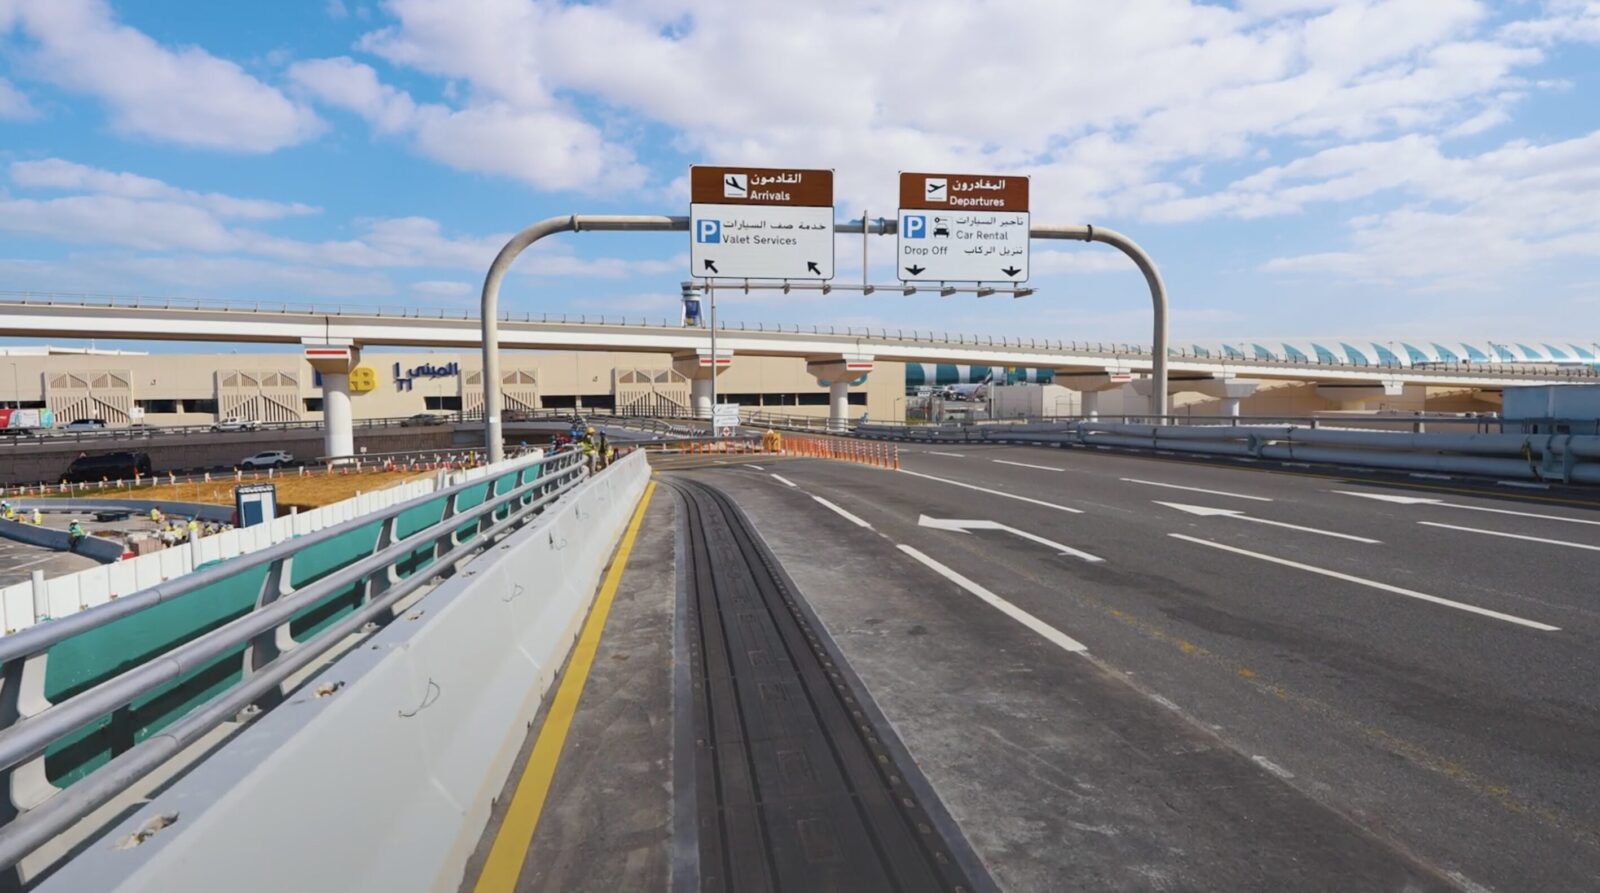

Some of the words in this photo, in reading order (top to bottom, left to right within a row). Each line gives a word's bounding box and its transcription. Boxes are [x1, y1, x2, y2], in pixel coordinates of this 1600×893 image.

[750, 173, 802, 185] القادمون
[952, 179, 1006, 191] المغادرون
[750, 190, 791, 201] Arrivals
[949, 196, 1005, 207] Departures
[723, 220, 767, 231] السيارات
[770, 222, 794, 230] صف
[798, 222, 827, 230] خدمة
[955, 216, 996, 227] السيارات
[701, 221, 718, 243] P
[908, 217, 923, 238] P
[722, 235, 750, 244] Valet
[753, 235, 798, 245] Services
[956, 230, 974, 240] Car
[976, 230, 1008, 241] Rental
[904, 245, 929, 256] Drop
[931, 246, 948, 255] Off
[964, 246, 996, 255] الركاب
